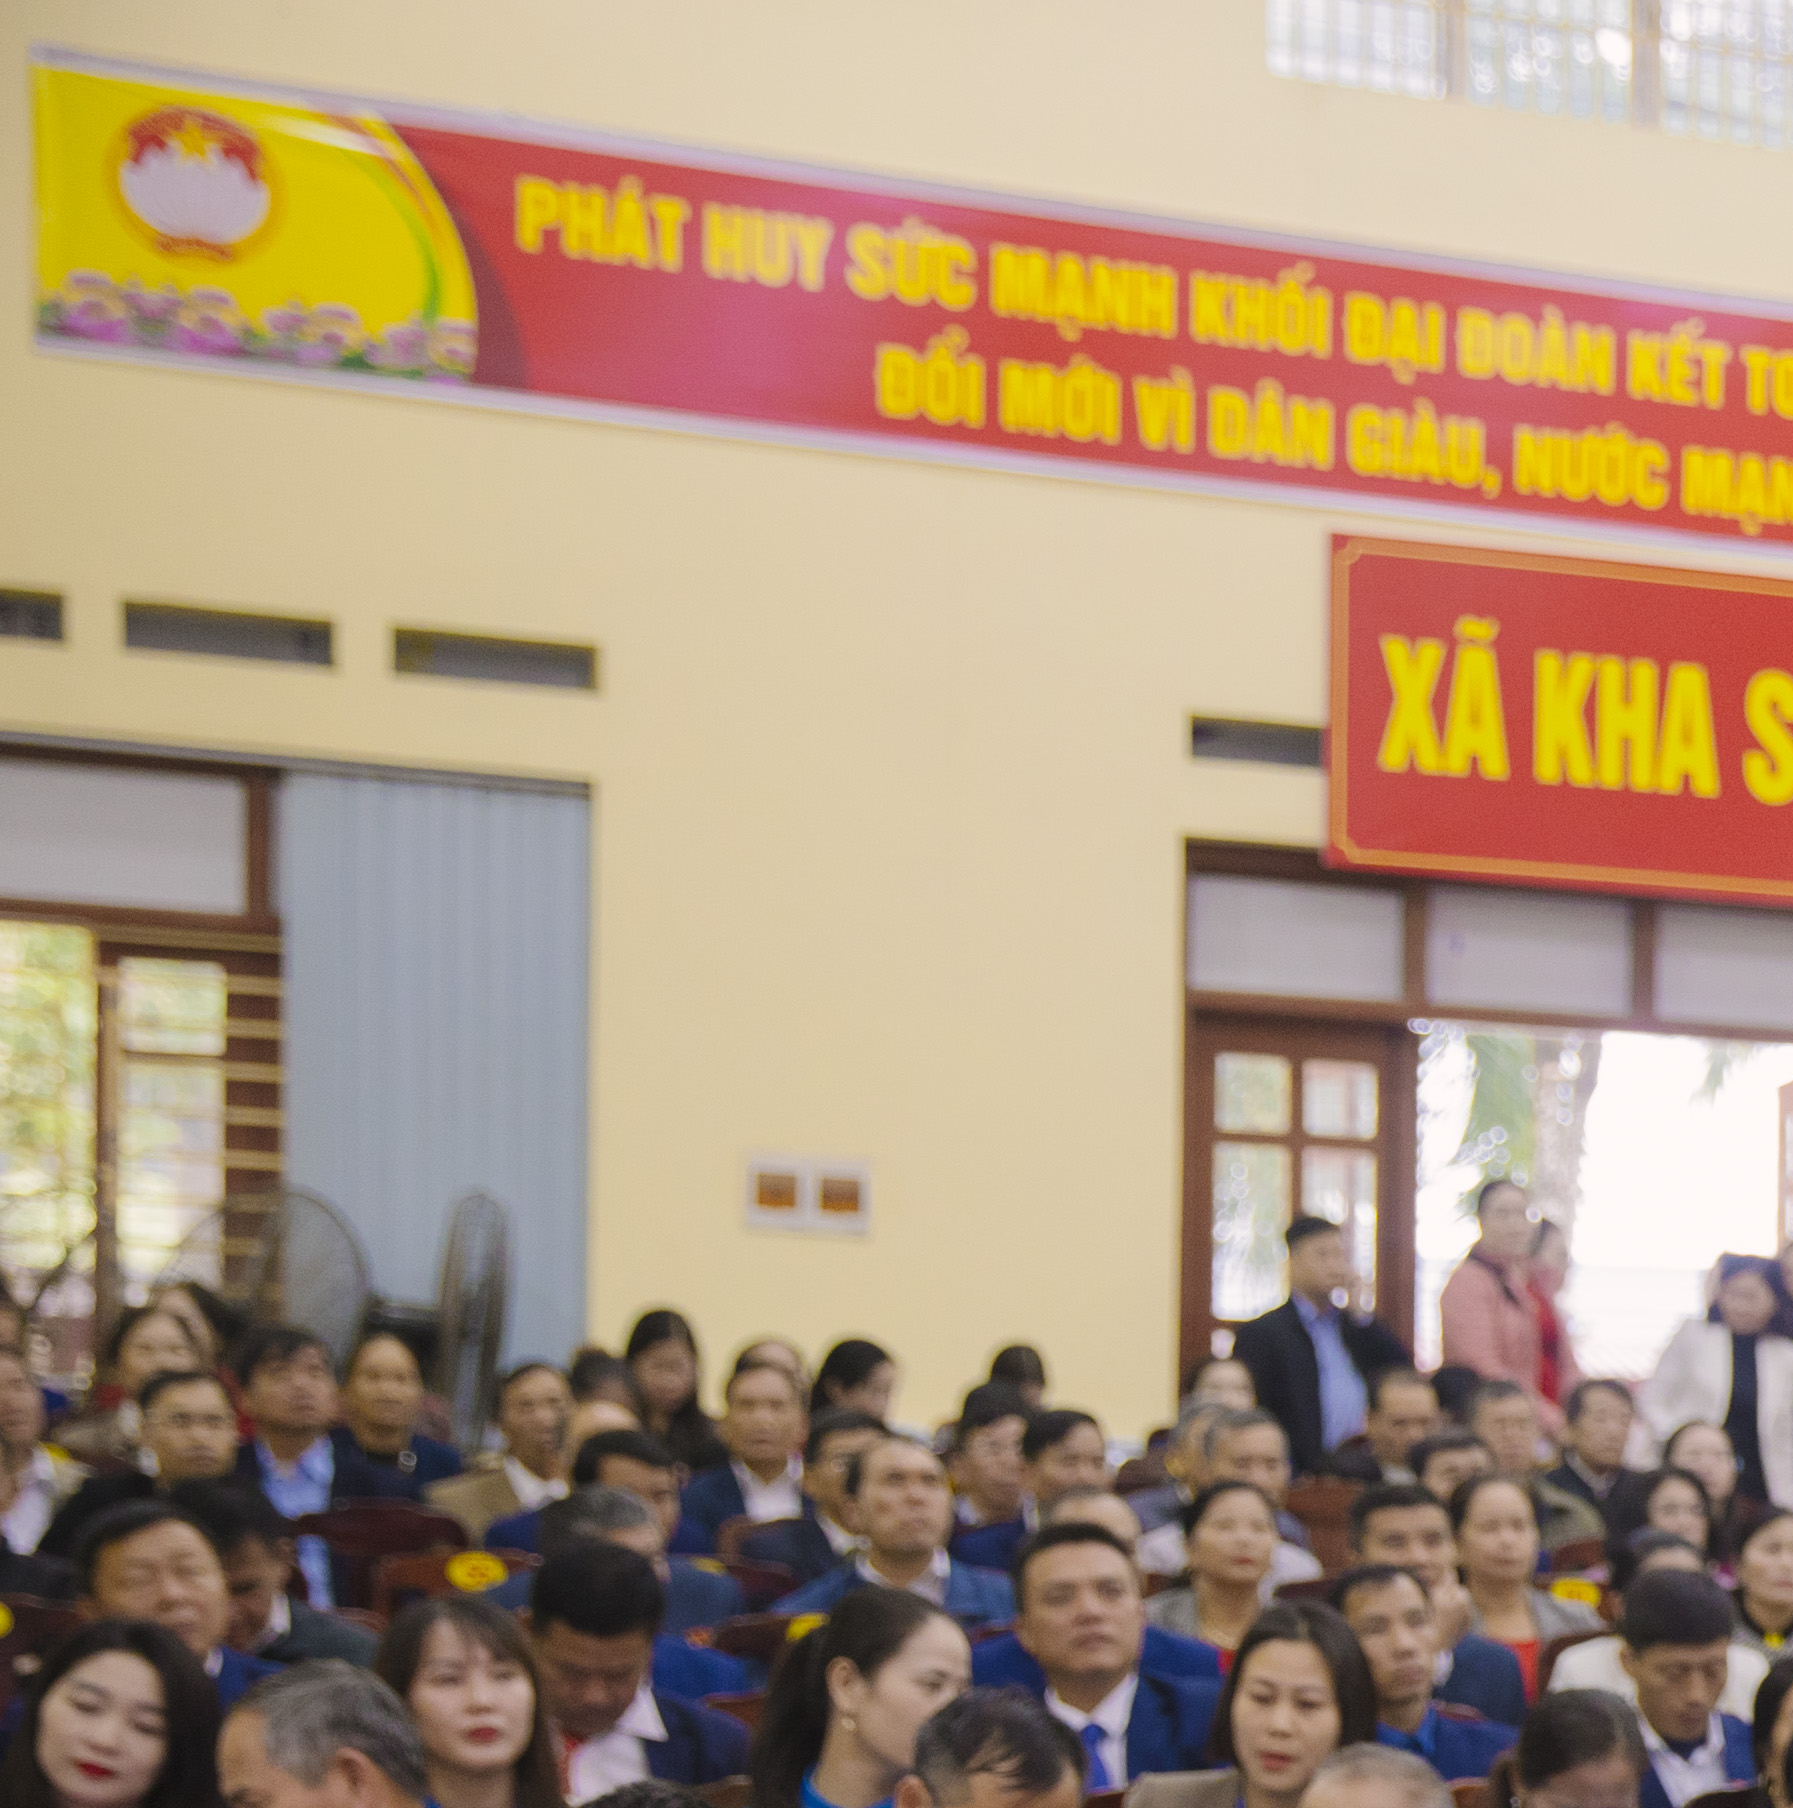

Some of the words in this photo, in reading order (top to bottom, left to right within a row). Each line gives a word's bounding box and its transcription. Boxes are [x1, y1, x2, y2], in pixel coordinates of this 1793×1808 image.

[517, 179, 686, 266] PHÁT
[704, 207, 831, 288] HUY
[847, 221, 976, 312] SỨC
[991, 246, 1176, 339] MẠNH
[1190, 264, 1331, 355] KHỐI
[1344, 292, 1443, 382] ĐẠI
[1460, 311, 1613, 392] ĐOÀN
[1629, 333, 1726, 407] KẾT
[878, 331, 984, 426] ĐỔI
[1000, 358, 1121, 442] MỚI
[1134, 377, 1193, 450] VÌ
[1210, 385, 1332, 467] DÂN
[1349, 408, 1500, 492] GIÀU,
[1514, 429, 1669, 509] NƯỚC
[1380, 618, 1509, 780] XÃ
[1534, 651, 1719, 797] KHA
